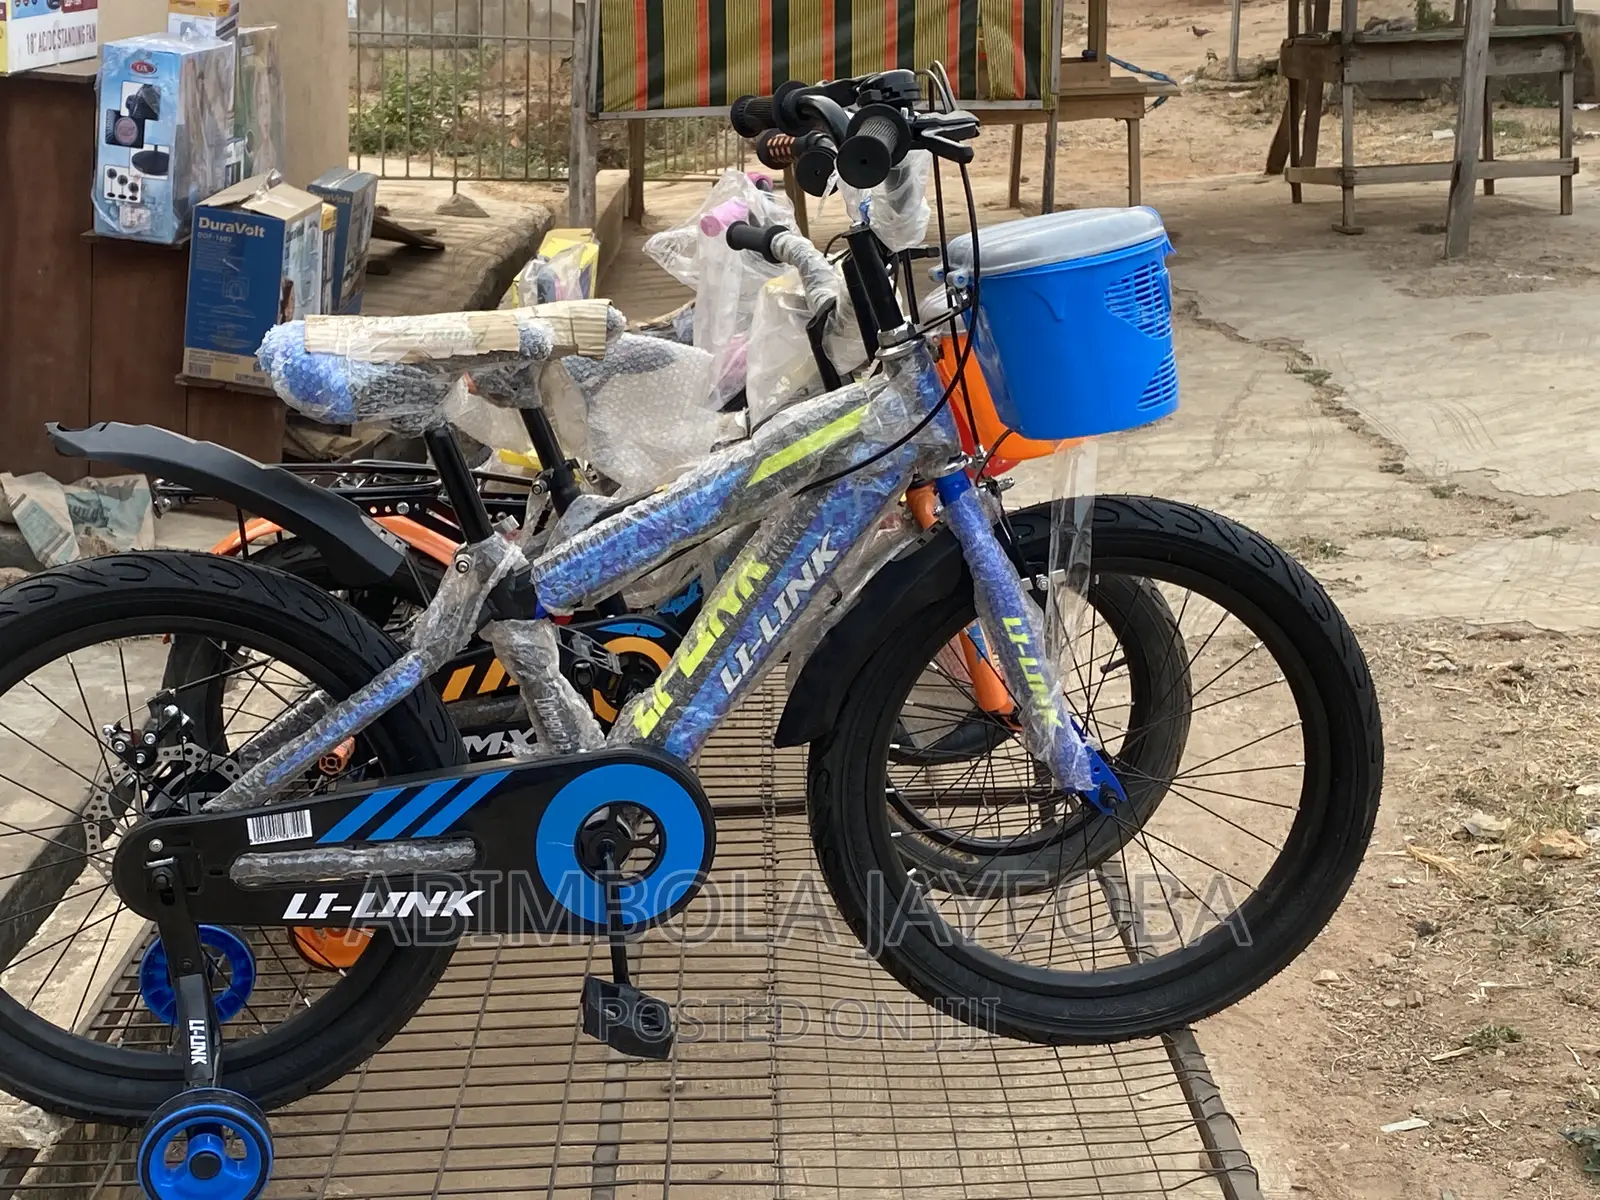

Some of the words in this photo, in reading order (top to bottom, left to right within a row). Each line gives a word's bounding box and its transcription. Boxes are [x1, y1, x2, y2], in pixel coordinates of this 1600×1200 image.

[86, 23, 97, 43] FAN
[198, 217, 265, 238] DuraVolt
[719, 531, 839, 694] LI-LINK
[1002, 617, 1064, 729] LI-LINK
[282, 890, 486, 919] LI-LINK
[188, 1019, 208, 1065] LI-LINK
